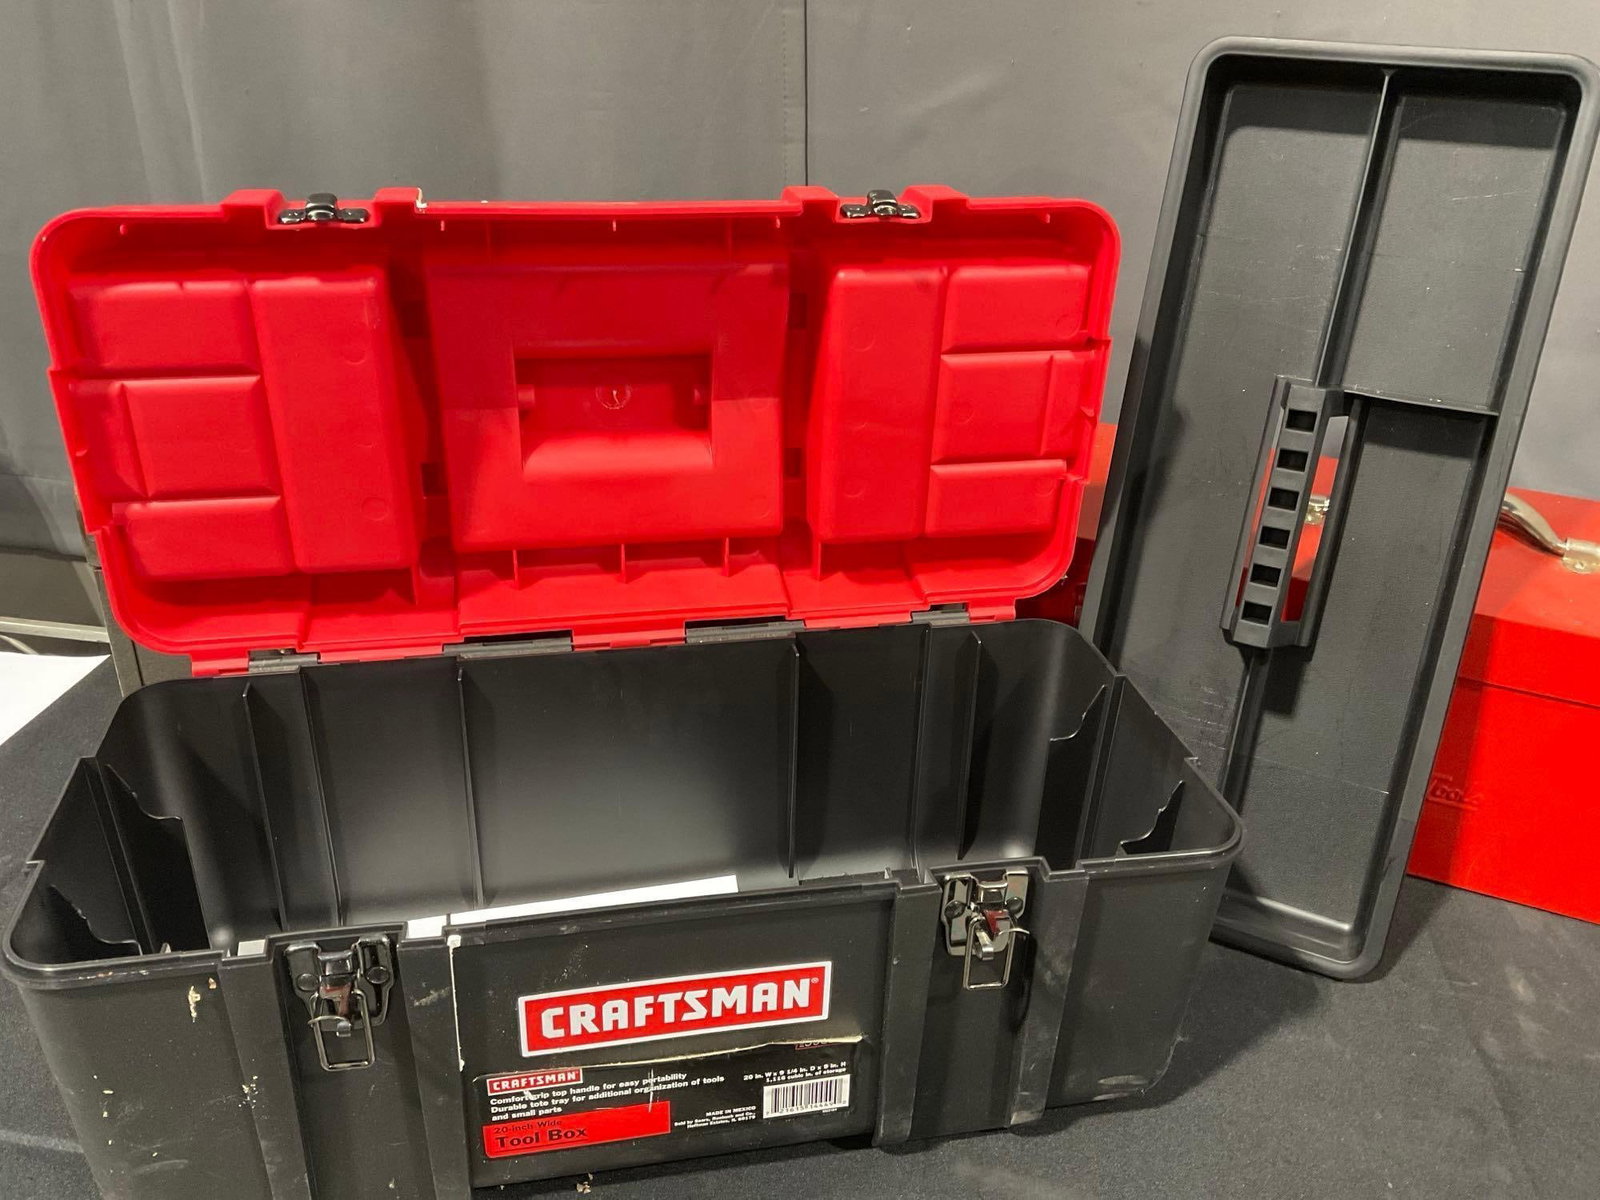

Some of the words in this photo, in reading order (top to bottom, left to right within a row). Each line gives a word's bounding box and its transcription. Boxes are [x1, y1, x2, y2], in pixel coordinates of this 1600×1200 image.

[492, 1072, 576, 1091] CRAFTSMAN
[552, 1090, 568, 1099] top
[570, 1084, 600, 1096] handle
[602, 1082, 616, 1090] for
[619, 1079, 640, 1090] easy
[642, 1072, 688, 1086] portability
[491, 1102, 528, 1114] Durable
[530, 1099, 548, 1109] tote
[551, 1097, 569, 1108] tray
[572, 1093, 586, 1102] for
[588, 1088, 632, 1100] additional
[634, 1081, 688, 1094] organization
[690, 1078, 702, 1086] of
[702, 1075, 725, 1086] tools
[492, 1112, 509, 1122] and
[511, 1108, 536, 1119] small
[538, 1105, 562, 1116] parts
[494, 1123, 533, 1134] 20-inch
[537, 1120, 562, 1128] Wide
[497, 1133, 540, 1148] Tool
[548, 1128, 587, 1141] Box
